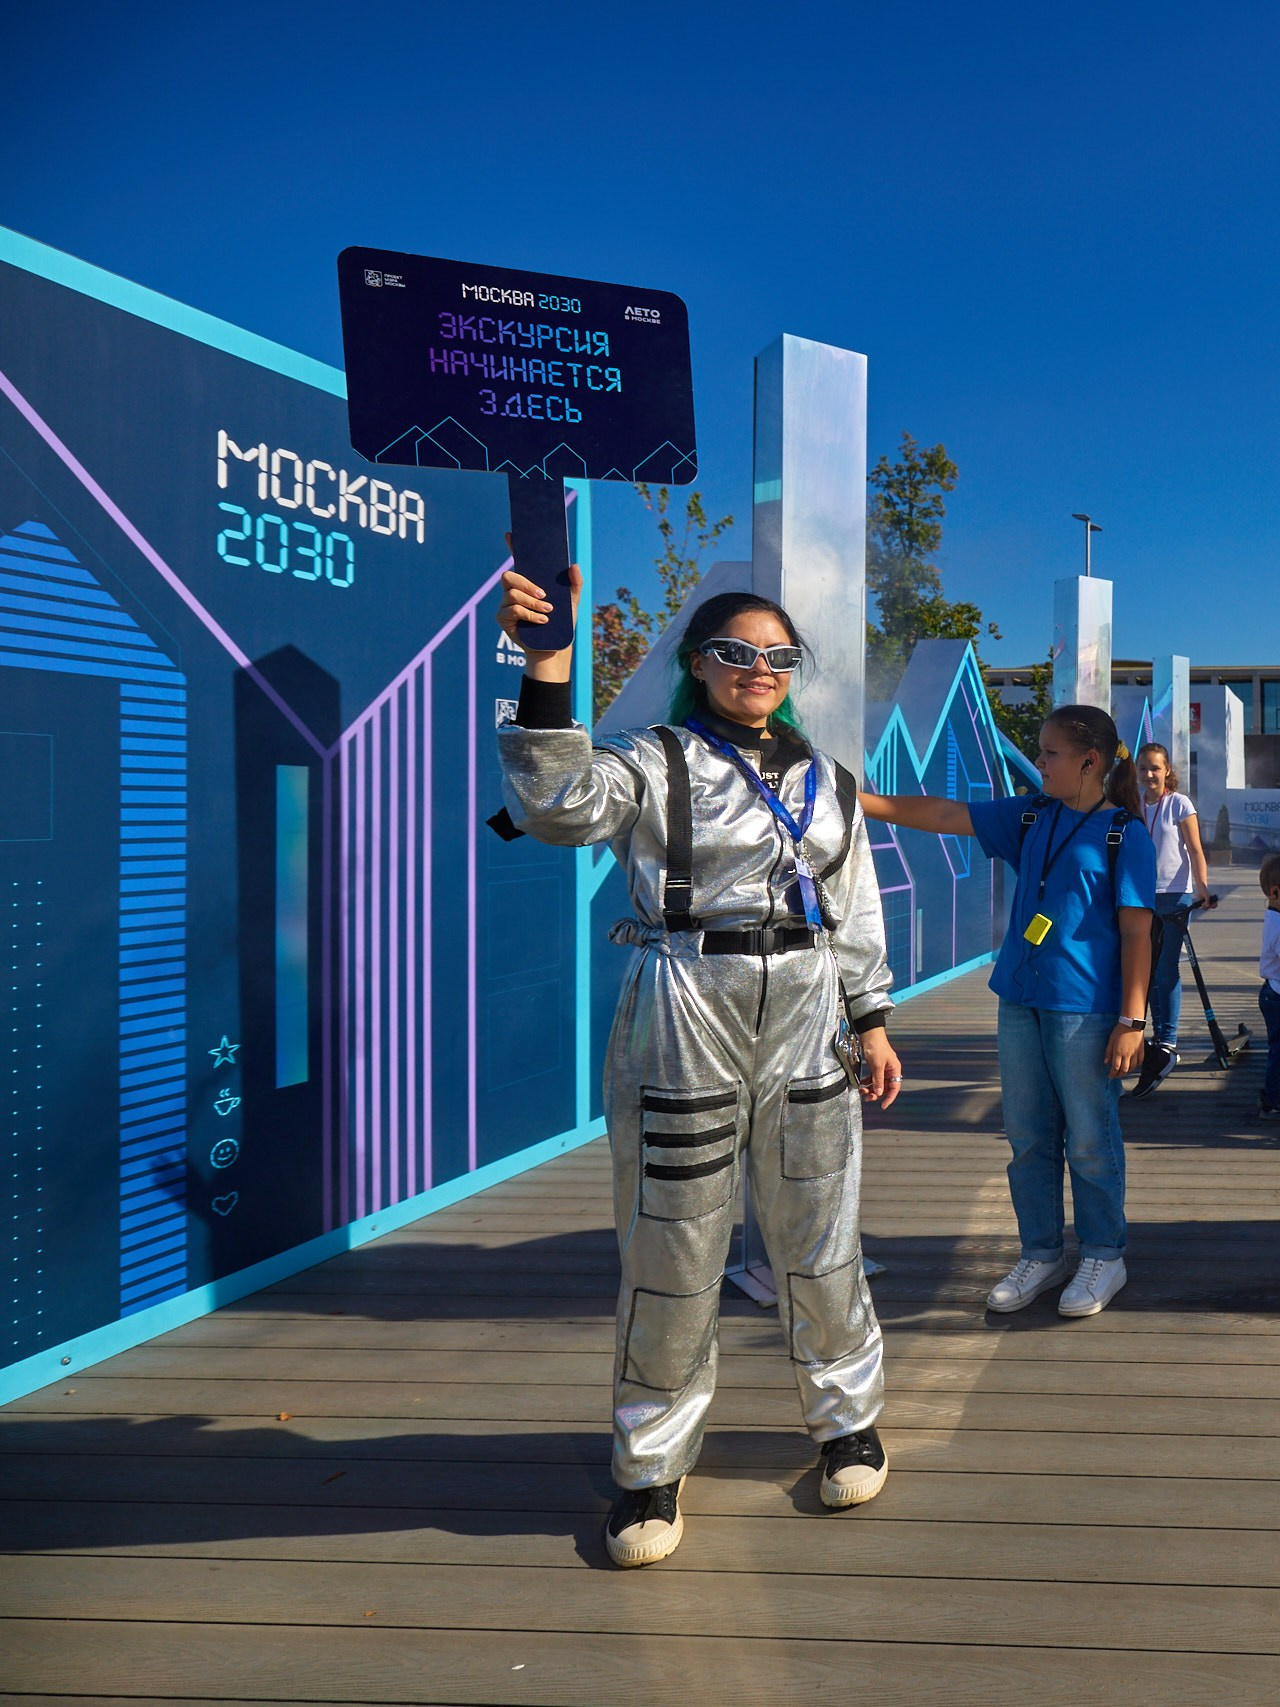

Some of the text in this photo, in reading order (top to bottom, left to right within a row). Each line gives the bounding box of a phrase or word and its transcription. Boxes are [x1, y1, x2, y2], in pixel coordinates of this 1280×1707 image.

[461, 283, 582, 314] МОСКВА 2030
[624, 305, 661, 319] ЛЕТО
[437, 311, 610, 358] ЭКСКУРСИЯ
[631, 315, 661, 325] МОСКВЕ
[429, 347, 622, 393] НАЧИНАЕТСЯ
[478, 388, 583, 424] ЗДЕСЬ
[217, 429, 425, 545] МОСКВА
[216, 501, 355, 589] 2030
[496, 652, 506, 664] В
[1245, 812, 1270, 825] 2030
